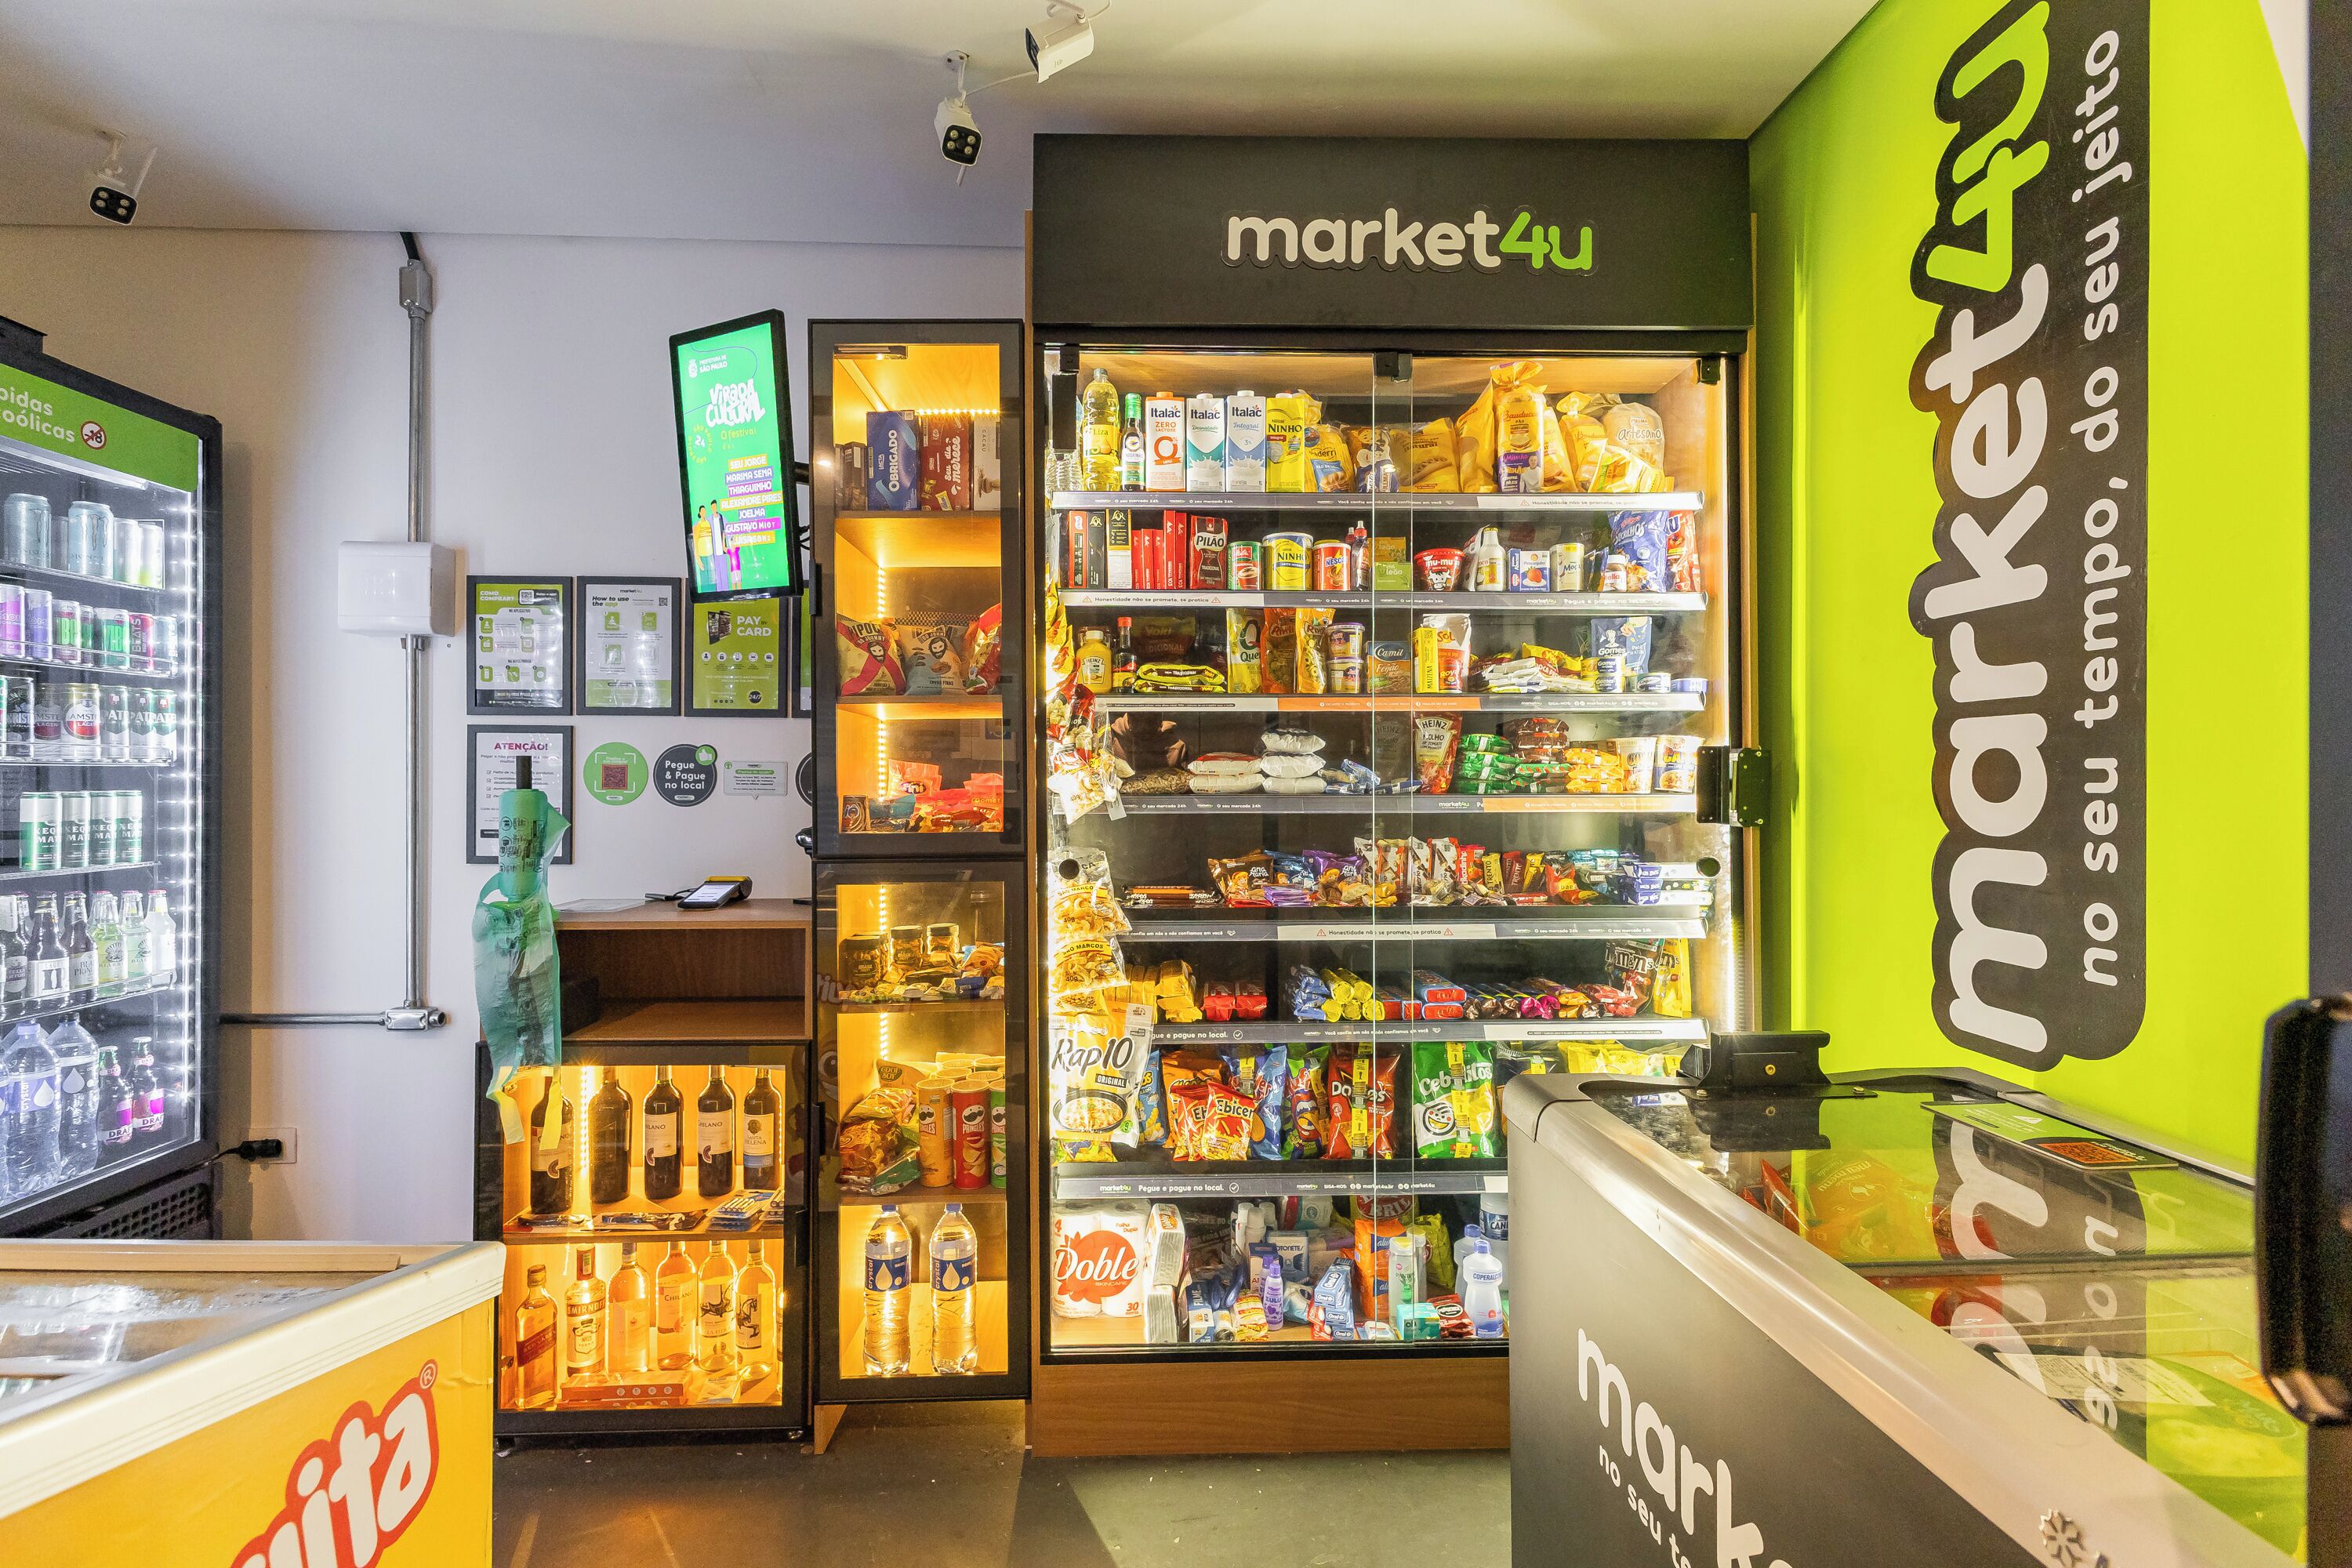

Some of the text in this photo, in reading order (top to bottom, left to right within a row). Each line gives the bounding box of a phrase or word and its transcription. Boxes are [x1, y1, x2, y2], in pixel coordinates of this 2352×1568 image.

[1228, 208, 1592, 270] market4u
[1151, 407, 1181, 419] Italac
[1190, 408, 1220, 420] Italac
[1232, 405, 1262, 418] Italac
[0, 409, 75, 443] oólicas
[1268, 423, 1302, 434] NINHO
[730, 456, 766, 470] SEU JORGE
[888, 430, 900, 492] OBRIGADO
[726, 468, 772, 483] MARINA SENA
[728, 481, 771, 495] THIAGUINHO
[720, 492, 782, 509] ALEXANDRE PIRES
[2071, 30, 2131, 985] no seu tempo, do seu jeito
[739, 508, 765, 520] JOELMA
[1925, 0, 2049, 1052] market4u
[1196, 534, 1224, 548] PILÃO
[736, 615, 761, 625] PAY
[736, 627, 771, 637] CARD
[1377, 648, 1404, 657] Camil
[1599, 648, 1626, 656] Gomes
[1376, 662, 1399, 674] Feijão
[1421, 720, 1447, 730] HEINZ
[494, 741, 548, 753] ATENÇÃO!
[665, 760, 695, 771] Pegue
[675, 771, 706, 781] Pague
[681, 781, 705, 789] local
[1097, 1074, 1125, 1087] ORIGINAL
[963, 1121, 985, 1134] PRINGLES
[1138, 1185, 1160, 1193] Pegue
[1054, 1247, 1139, 1281] Doble
[1599, 1445, 1661, 1545] no seu
